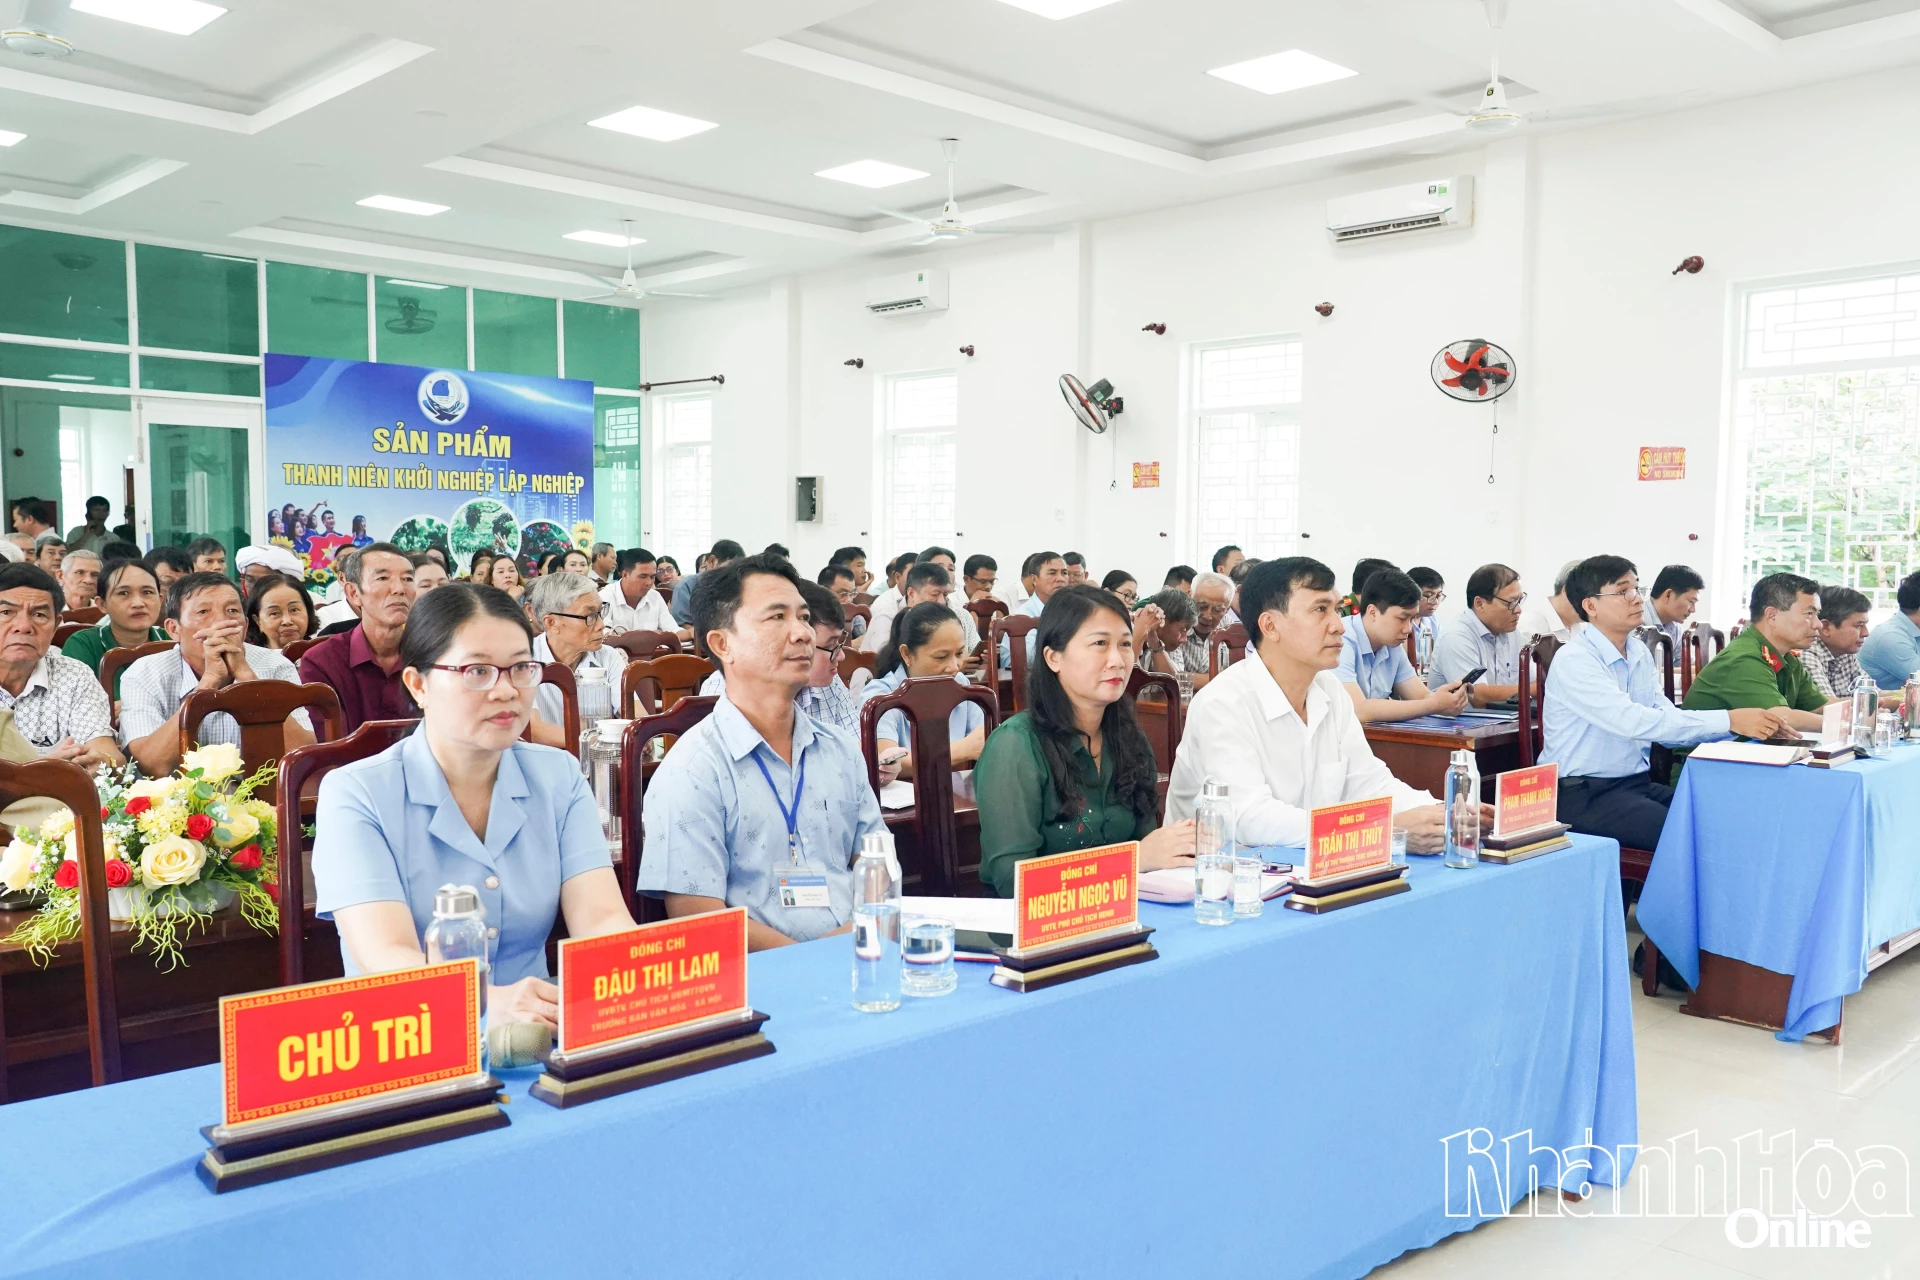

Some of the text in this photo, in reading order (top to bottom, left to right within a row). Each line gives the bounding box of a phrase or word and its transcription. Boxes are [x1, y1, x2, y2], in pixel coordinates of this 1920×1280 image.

[372, 421, 511, 459] SẢN PHẨM
[282, 462, 585, 498] THANH NIÊN KHỞI NGHIỆP LẬP NGHIỆP
[1520, 790, 1537, 807] THANH
[1318, 821, 1384, 857] TRẦN THỊ THỦY
[1084, 862, 1098, 876] CHÍ
[1028, 874, 1127, 920] NGUYỄN NGỌC VŨ
[666, 936, 686, 951] CHÍ
[594, 951, 719, 1003] ĐẬU THỊ LAM
[278, 1002, 432, 1082] CHỦ TRÌ
